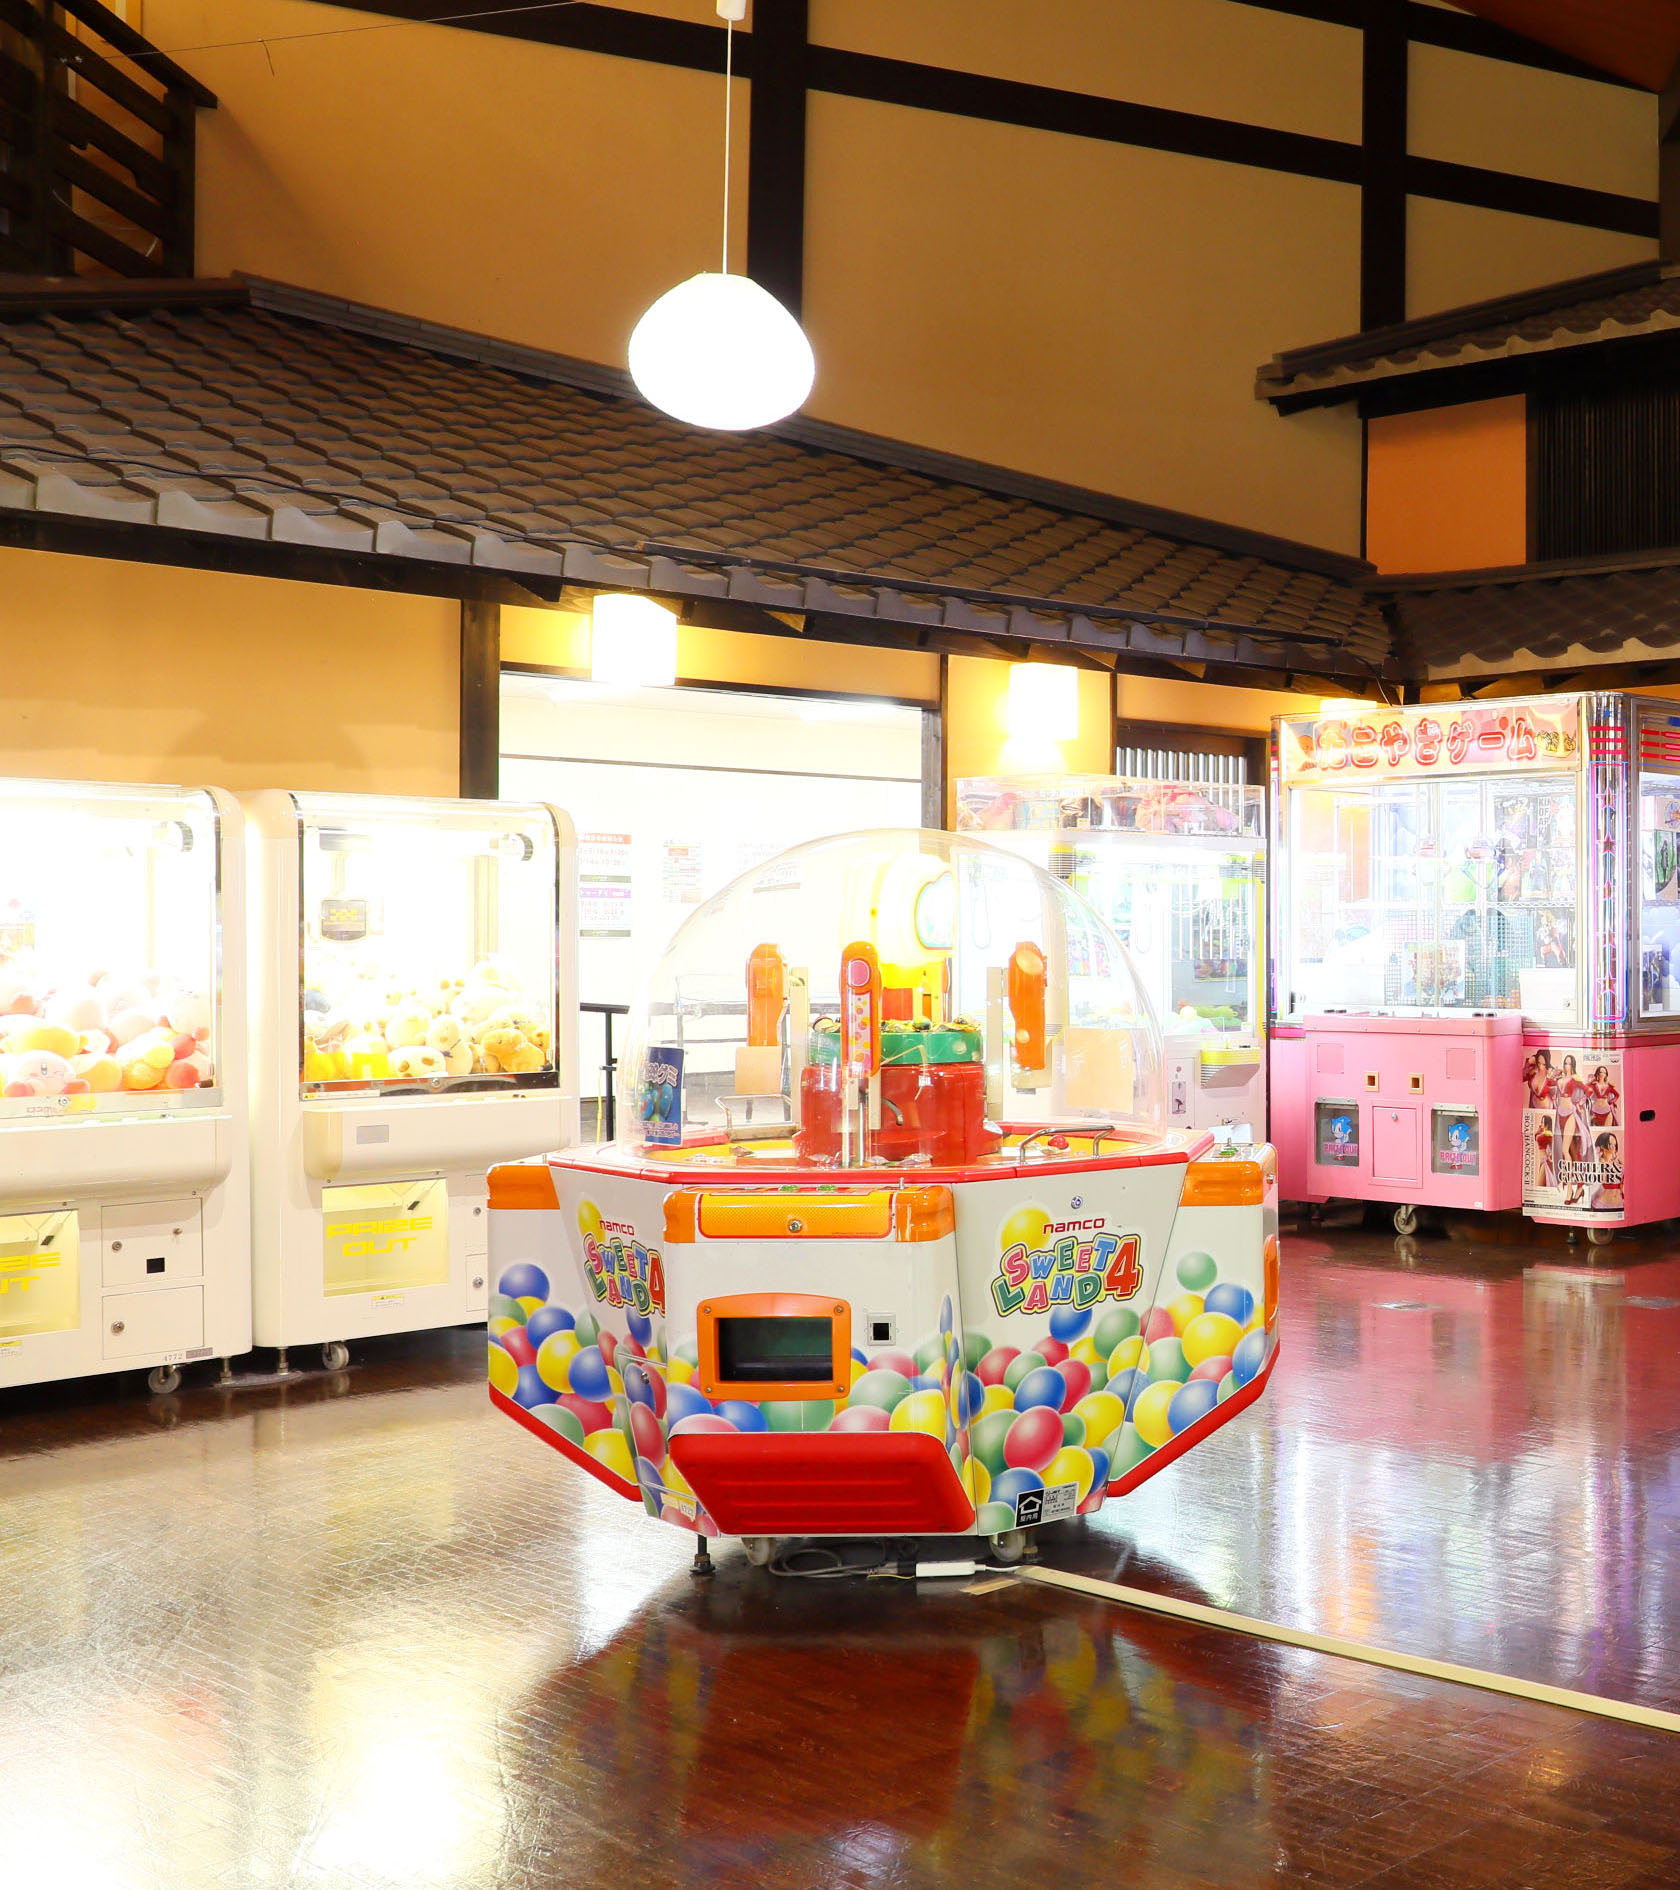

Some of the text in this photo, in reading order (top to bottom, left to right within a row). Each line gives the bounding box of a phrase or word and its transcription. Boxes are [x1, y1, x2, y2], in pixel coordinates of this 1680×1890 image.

[327, 1216, 432, 1239] PRIZE
[599, 1220, 635, 1236] namco
[1043, 1218, 1105, 1235] namco
[343, 1237, 416, 1257] OUT
[585, 1237, 649, 1282] SWEET
[1004, 1236, 1117, 1287] SWEET
[584, 1261, 651, 1313] LAND
[994, 1237, 1139, 1313] LAND 4
